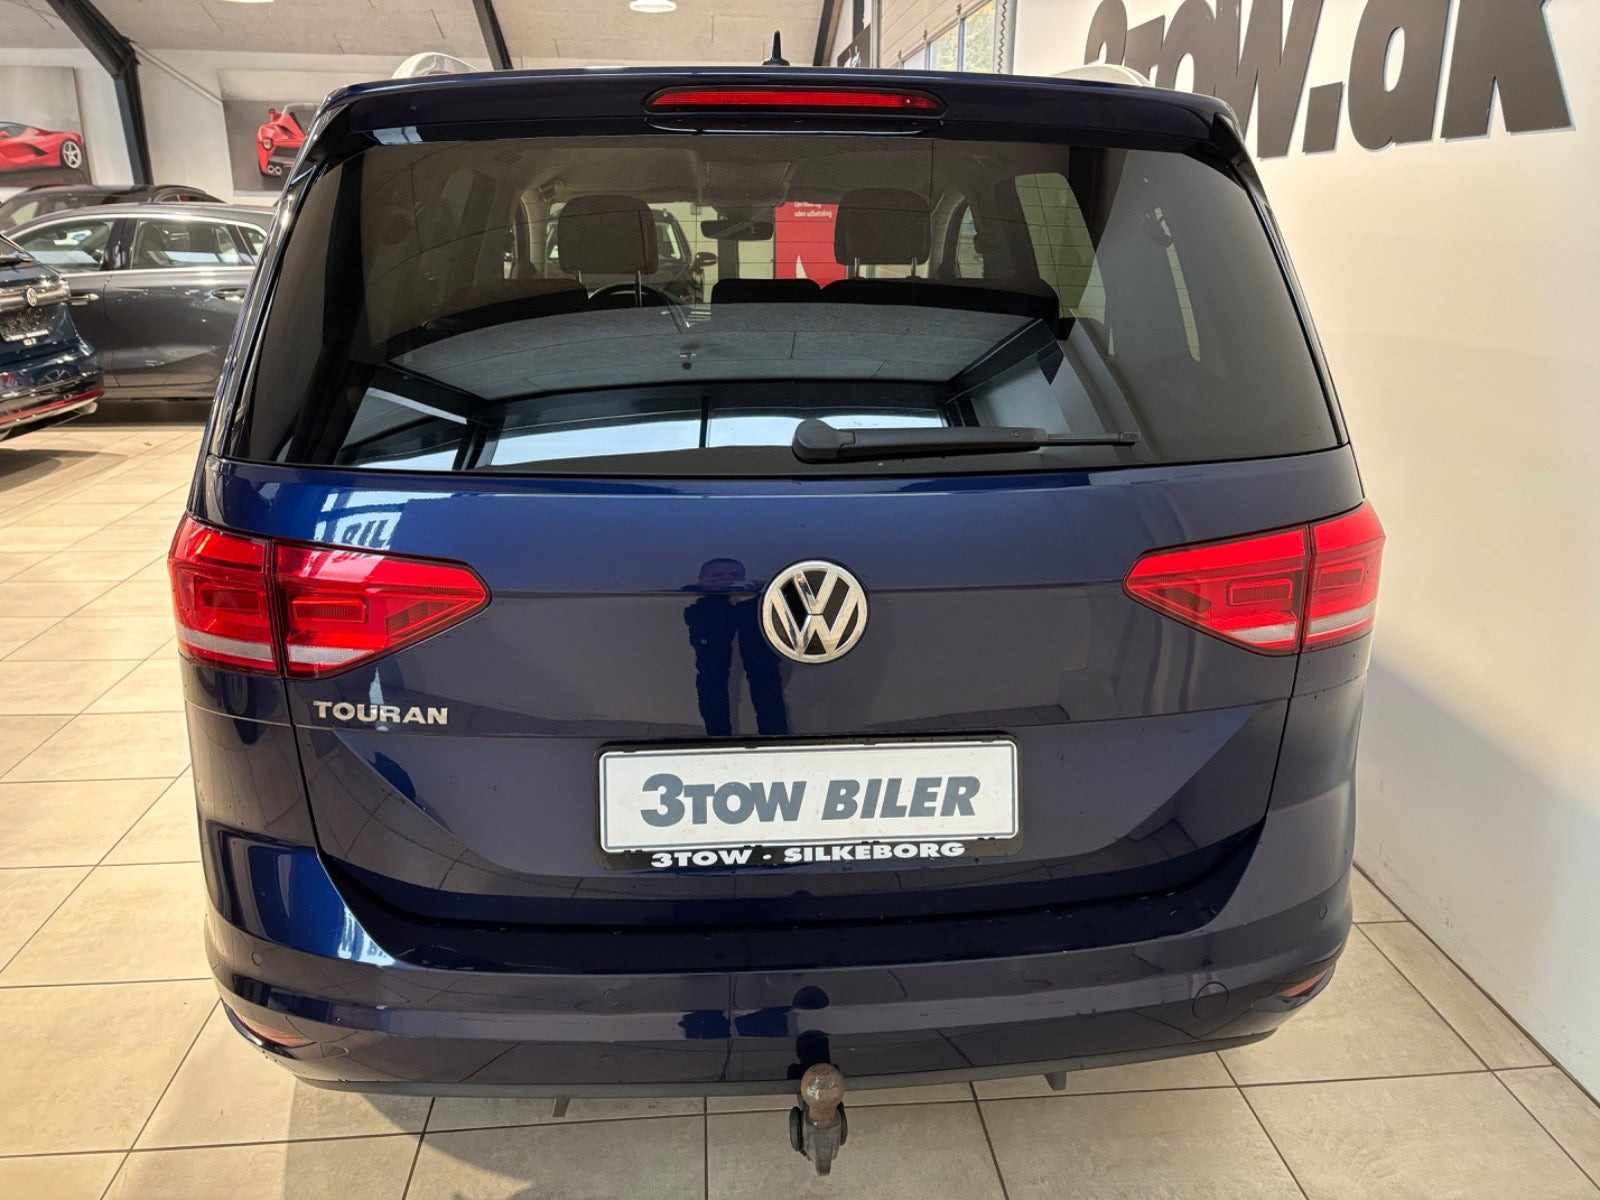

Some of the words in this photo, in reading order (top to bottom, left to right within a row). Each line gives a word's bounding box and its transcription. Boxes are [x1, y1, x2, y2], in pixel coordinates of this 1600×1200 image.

[313, 700, 448, 725] TOURAN
[640, 773, 806, 827] 3TOW
[821, 776, 980, 820] BILER
[651, 849, 752, 868] 3TOW
[784, 842, 965, 862] SILKEBORG
